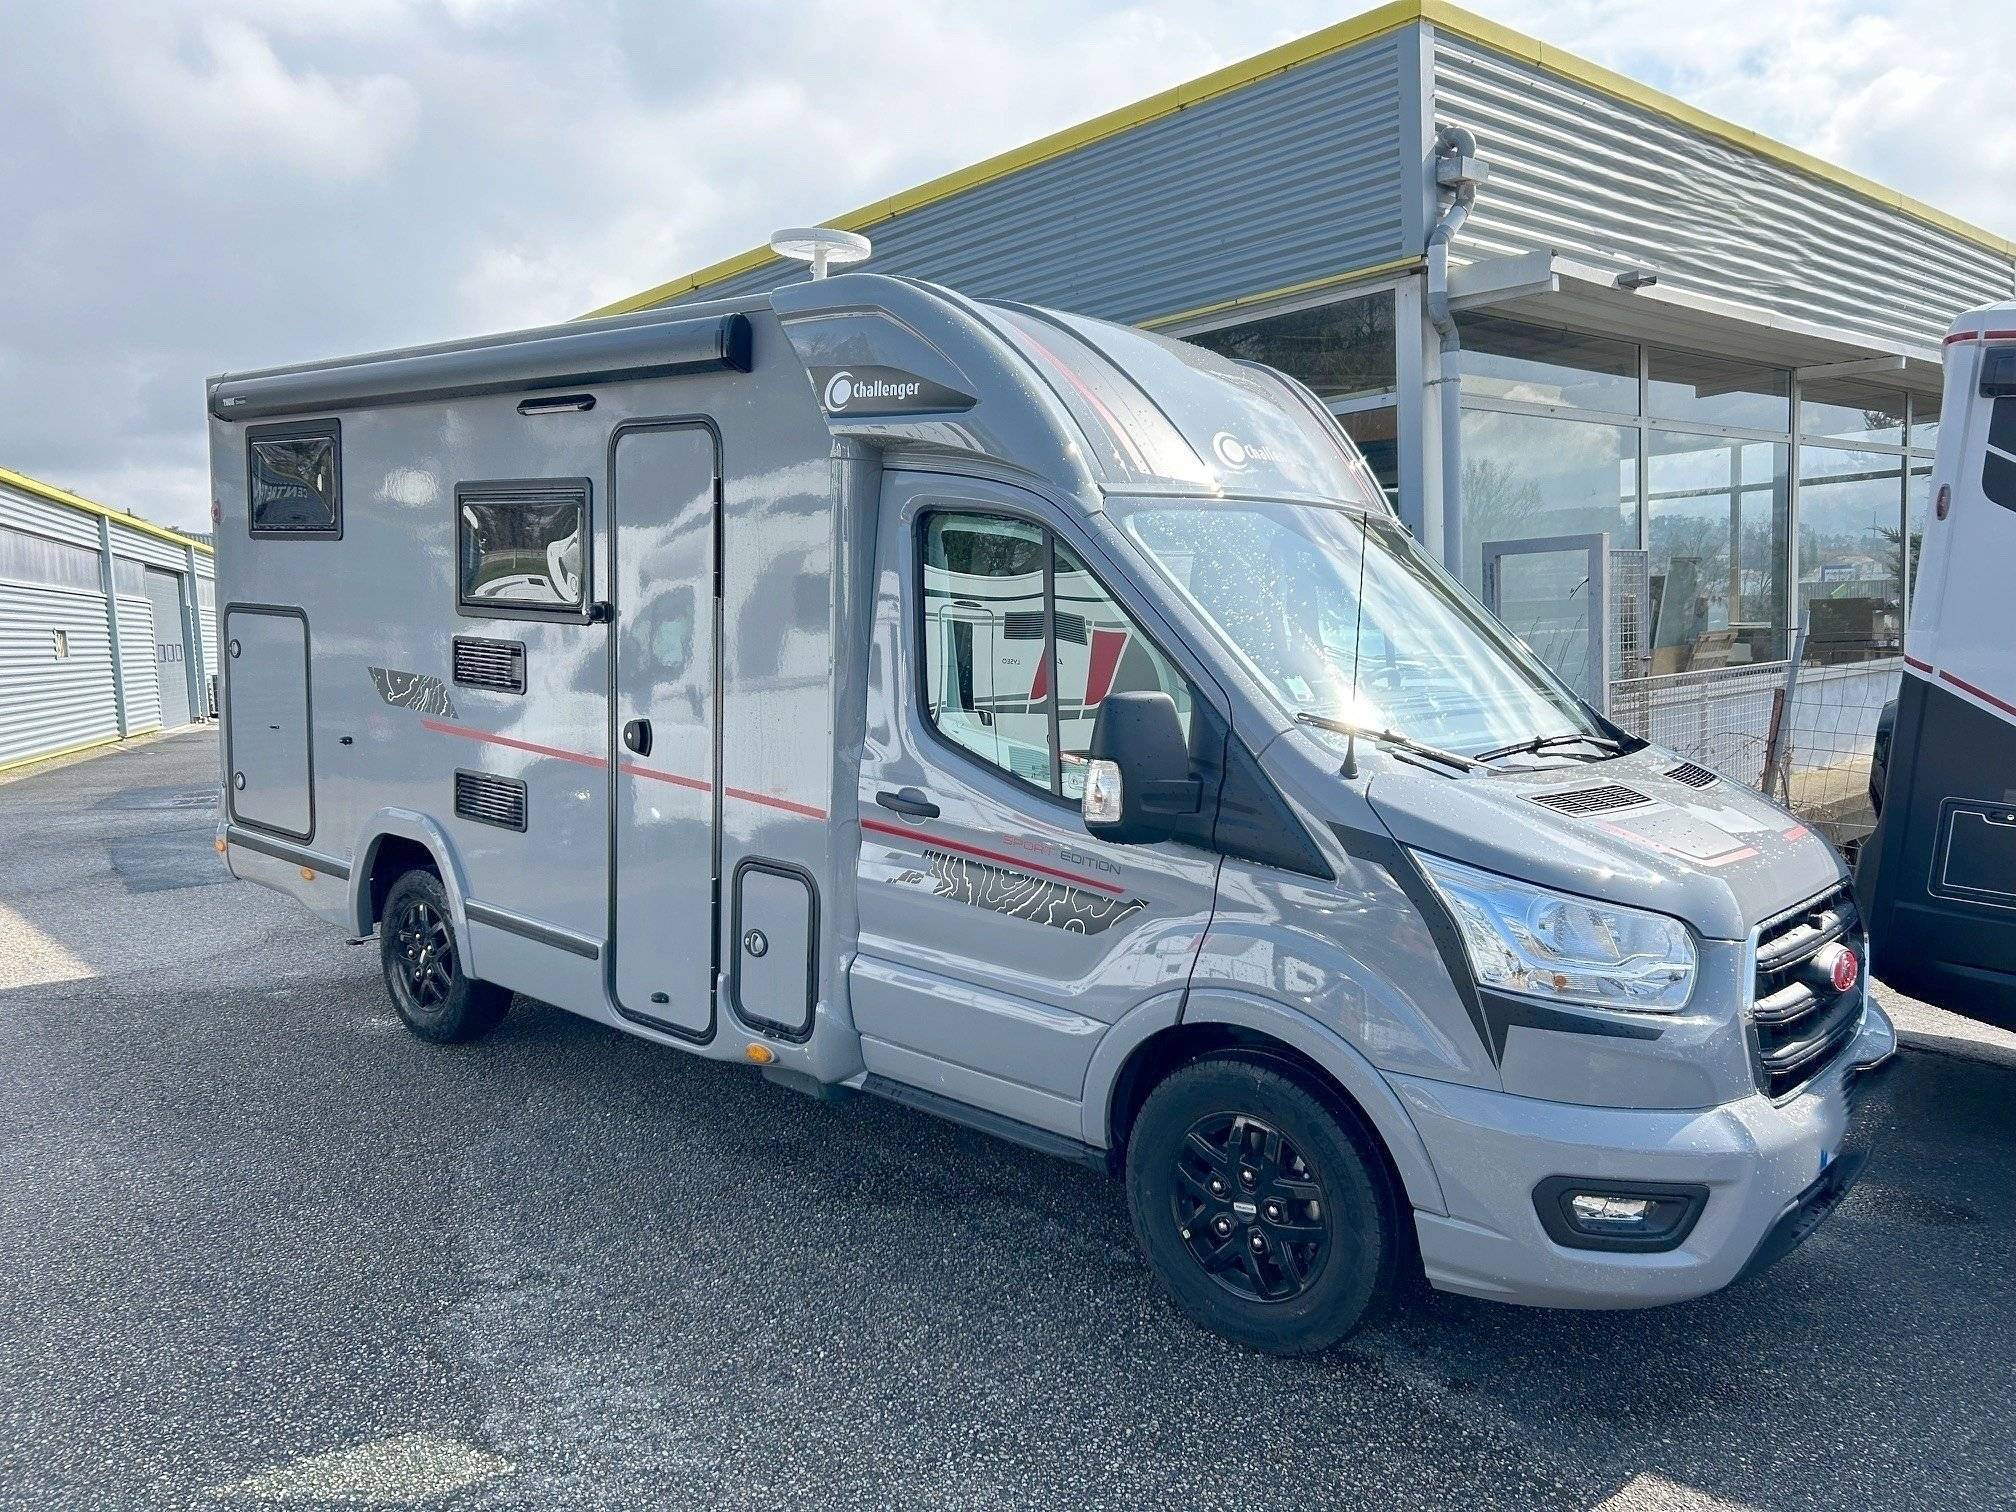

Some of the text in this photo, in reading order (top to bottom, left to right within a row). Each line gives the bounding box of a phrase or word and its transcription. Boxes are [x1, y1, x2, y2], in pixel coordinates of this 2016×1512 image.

[853, 380, 920, 400] Challenger
[1002, 833, 1121, 875] SPORT EDITION
